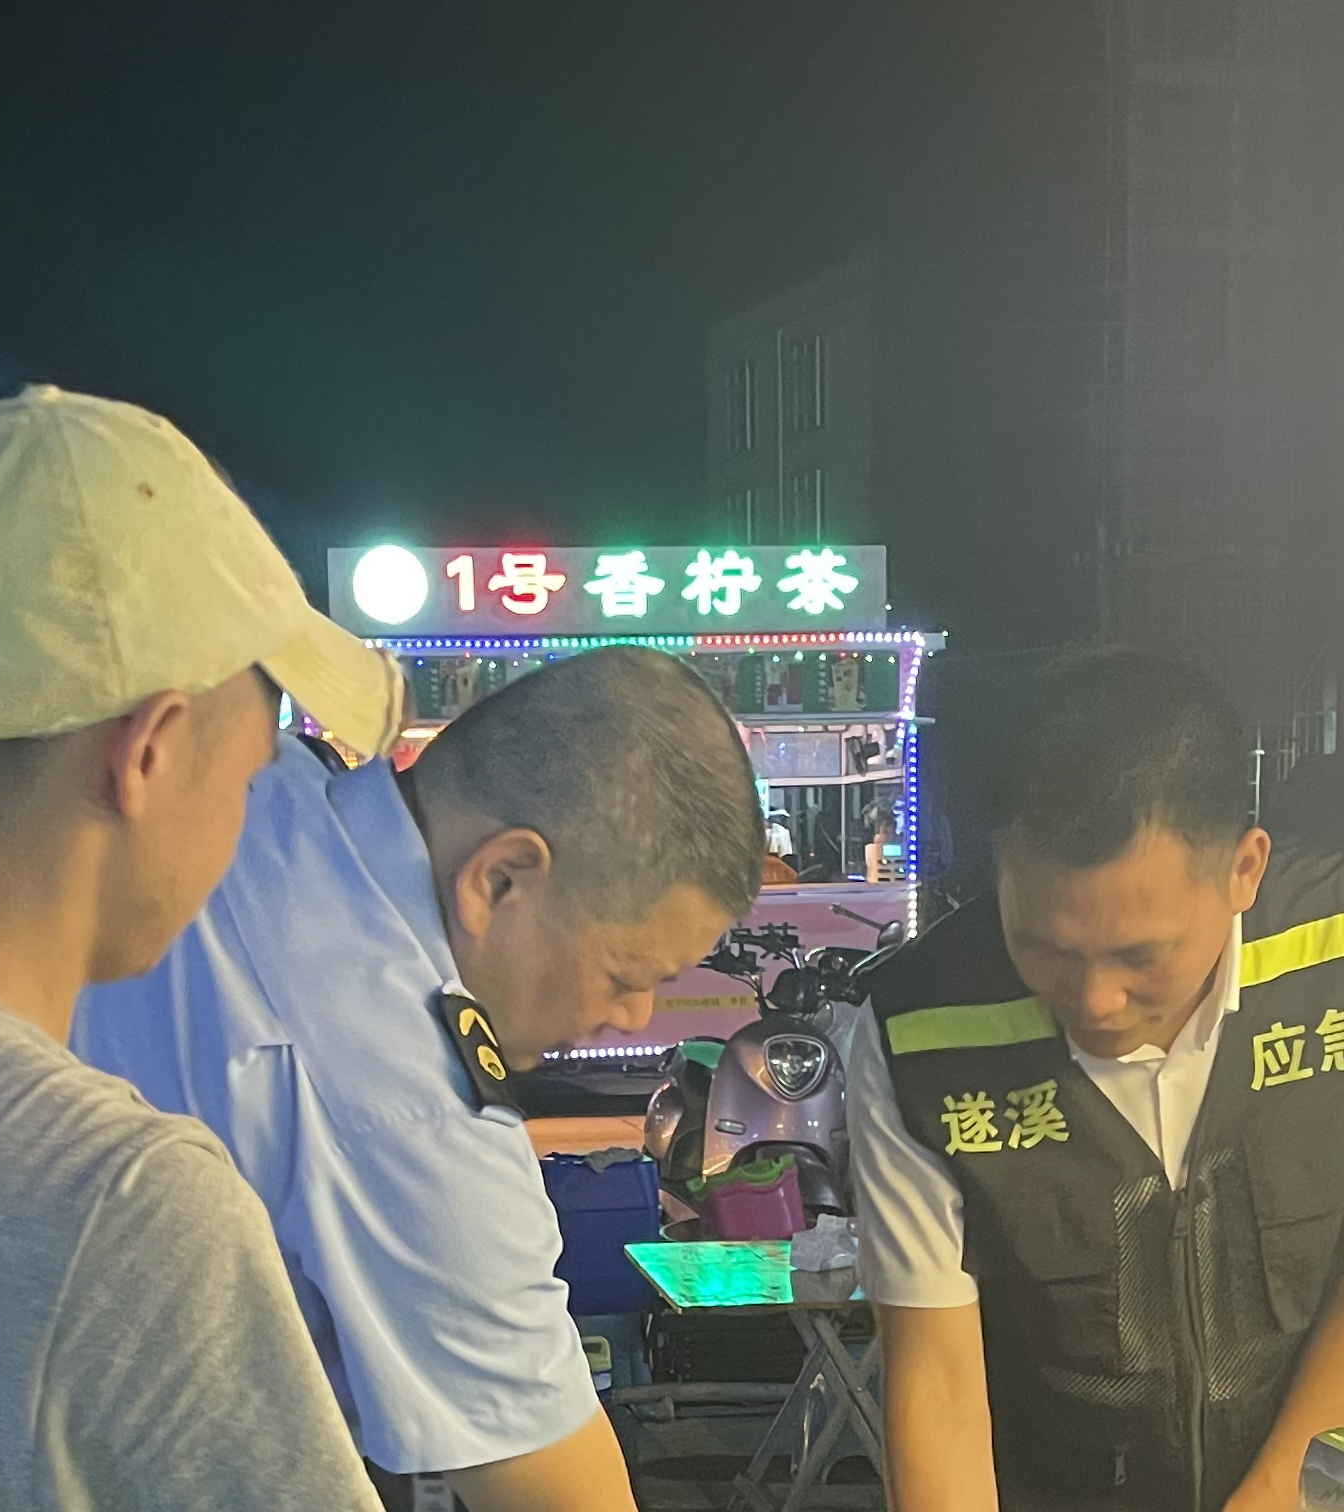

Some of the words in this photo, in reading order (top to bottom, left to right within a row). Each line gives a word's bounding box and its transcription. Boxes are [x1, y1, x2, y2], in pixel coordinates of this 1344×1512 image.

[445, 547, 859, 617] 1号香柠茶
[940, 1078, 1070, 1156] 遂溪
